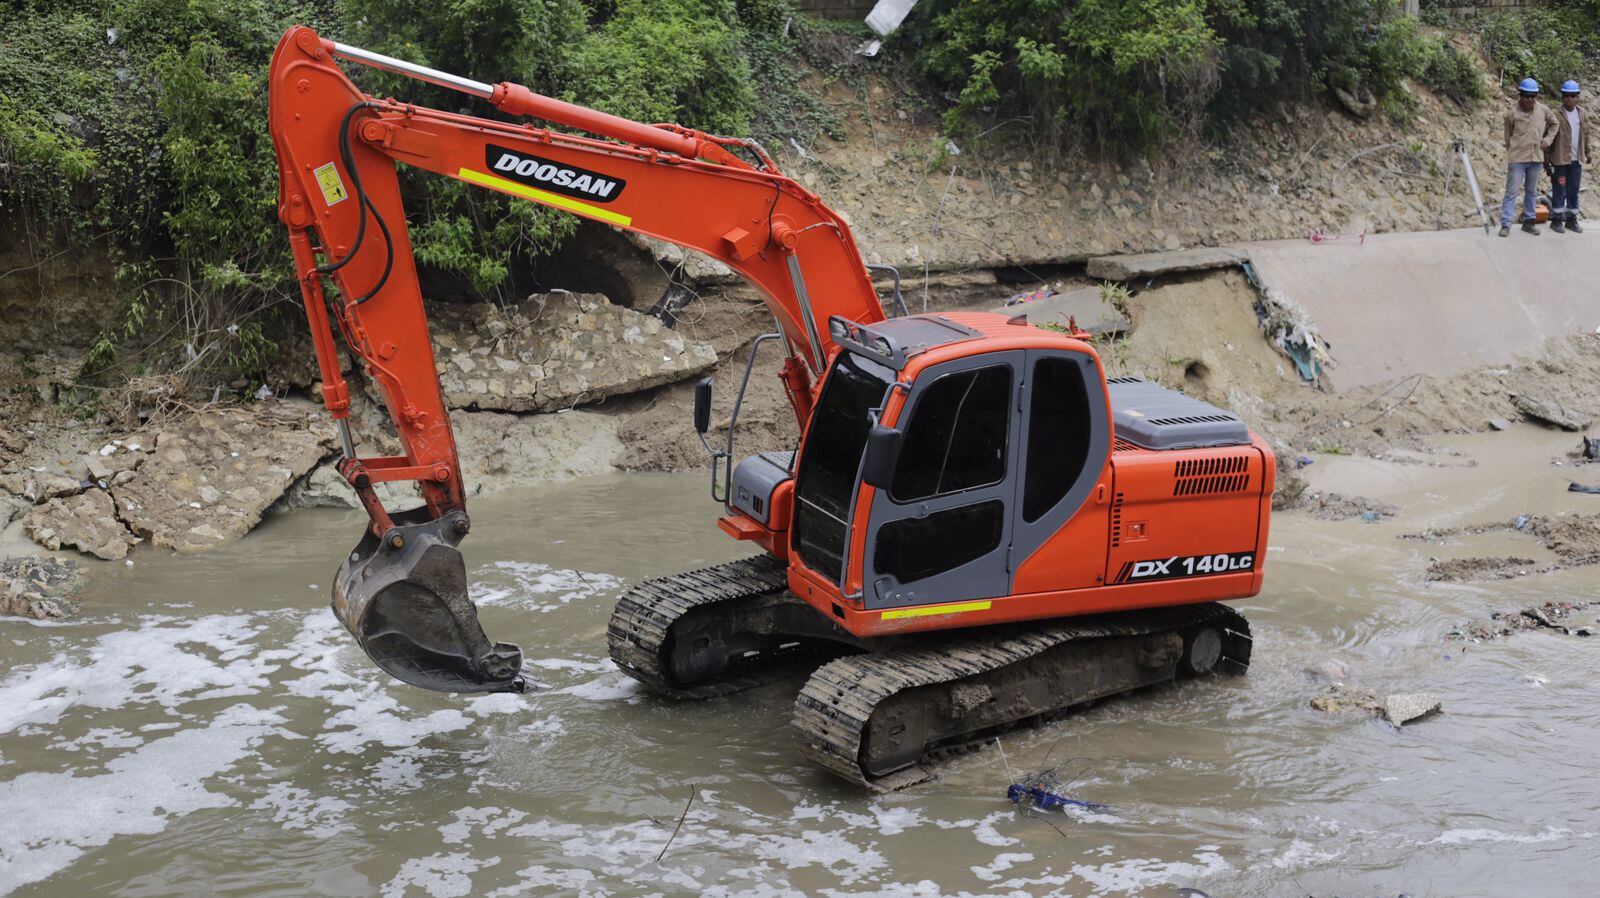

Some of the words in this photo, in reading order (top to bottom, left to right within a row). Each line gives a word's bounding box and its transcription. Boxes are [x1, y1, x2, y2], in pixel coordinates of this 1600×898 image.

[494, 153, 616, 197] DOOSAN
[1131, 556, 1178, 578] DX
[1182, 554, 1252, 575] 140LC
